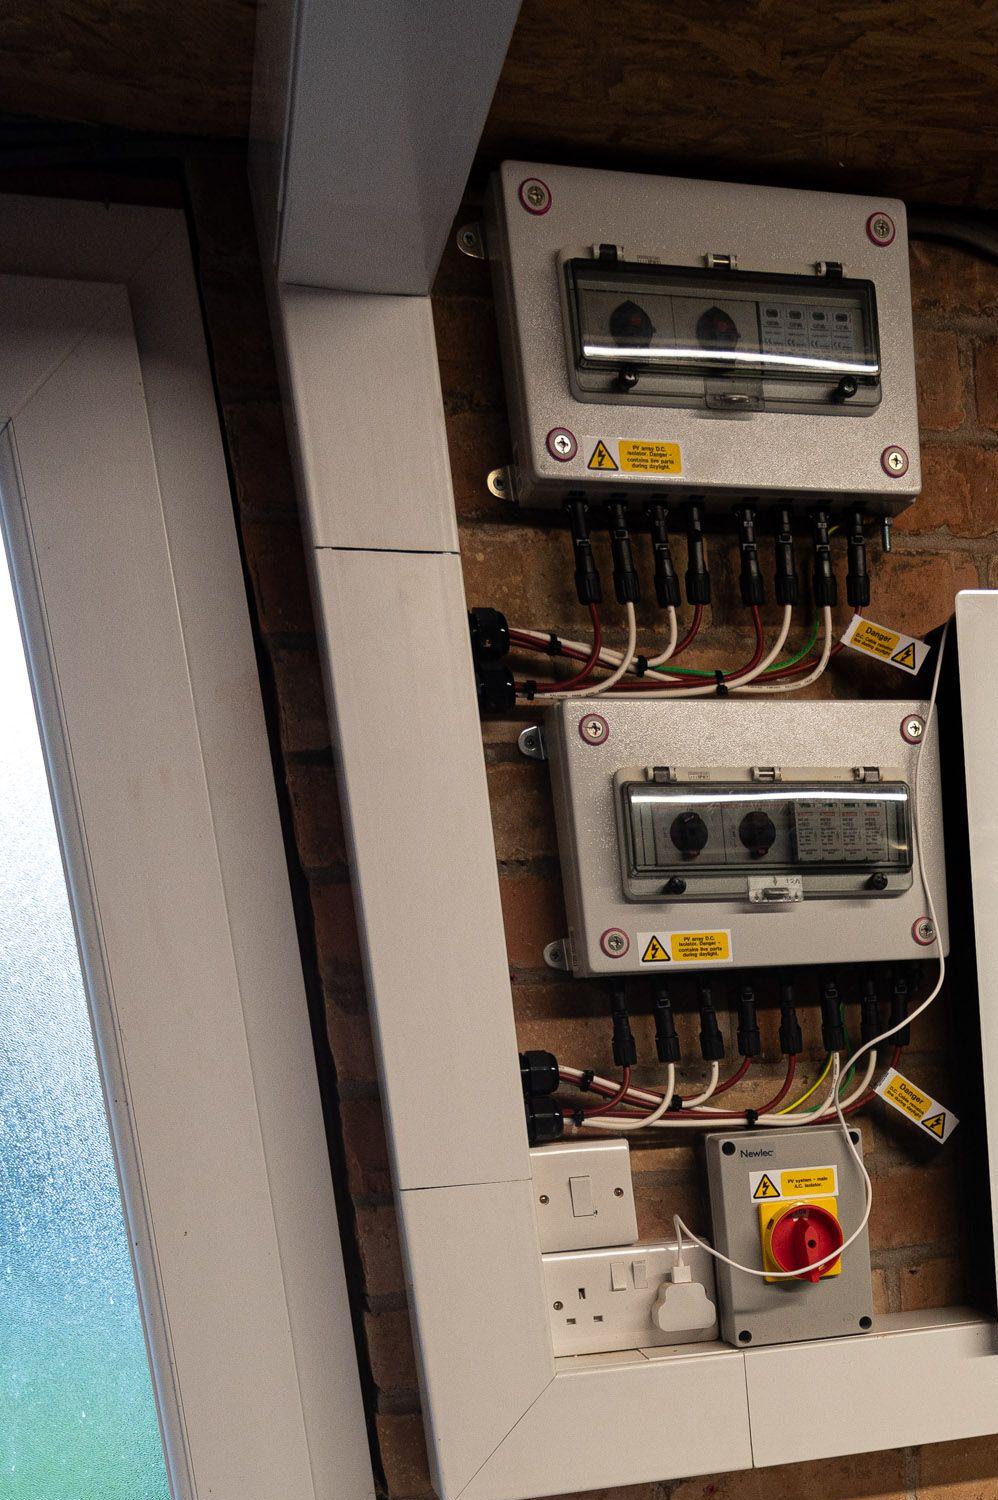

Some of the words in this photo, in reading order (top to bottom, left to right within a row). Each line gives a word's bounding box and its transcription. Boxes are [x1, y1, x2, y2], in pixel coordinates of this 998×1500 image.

[866, 627, 892, 642] Danger
[898, 1092, 909, 1102] Cable
[900, 1083, 924, 1104] Danger
[740, 1149, 774, 1158] Newlec
